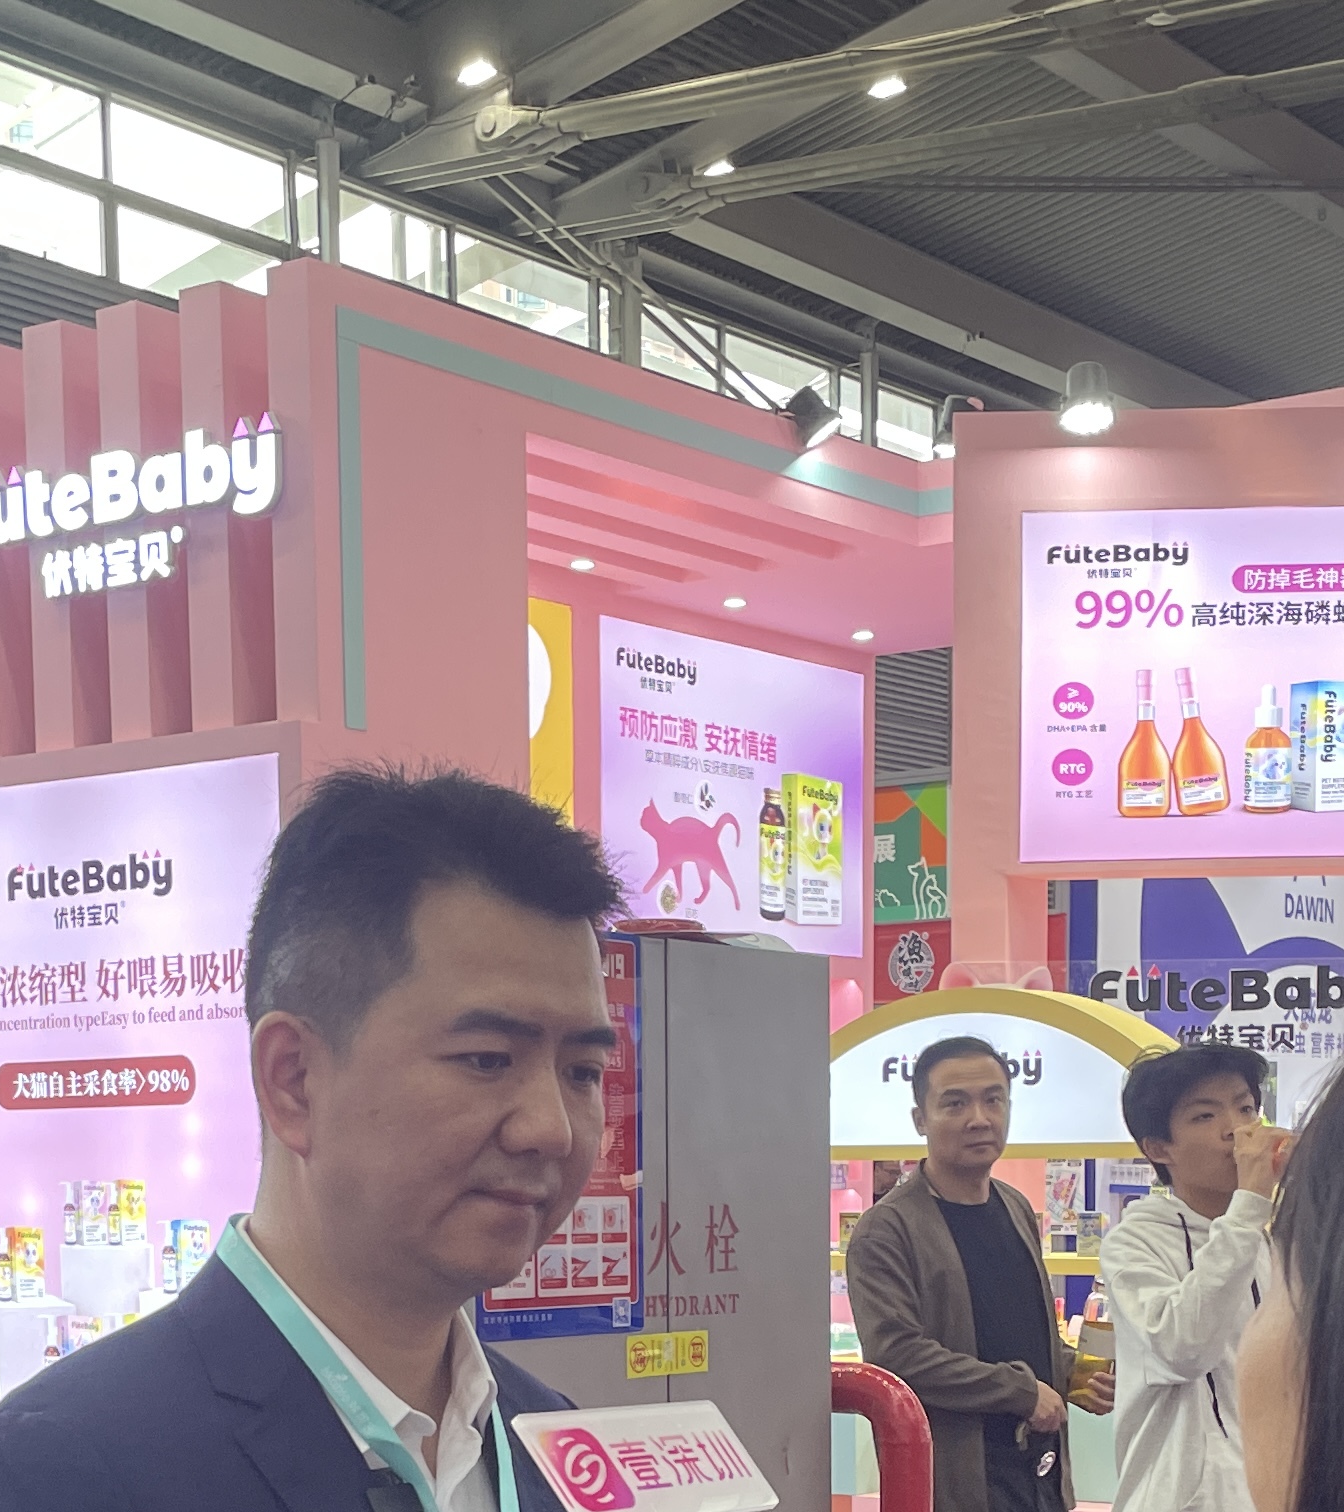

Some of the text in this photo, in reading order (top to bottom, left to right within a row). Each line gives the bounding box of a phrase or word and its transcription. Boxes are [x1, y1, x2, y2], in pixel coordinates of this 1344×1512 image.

[1075, 589, 1185, 629] 99%
[1059, 701, 1089, 713] 90%
[619, 706, 778, 765] 预防应激 安抚情绪
[1059, 763, 1087, 775] RTG
[1285, 892, 1335, 924] DAWIN
[132, 1009, 145, 1025] to
[147, 1006, 176, 1024] feed
[179, 1003, 204, 1022] and
[645, 1293, 741, 1318] HYDRANT
[608, 1429, 753, 1491] 壹深圳
